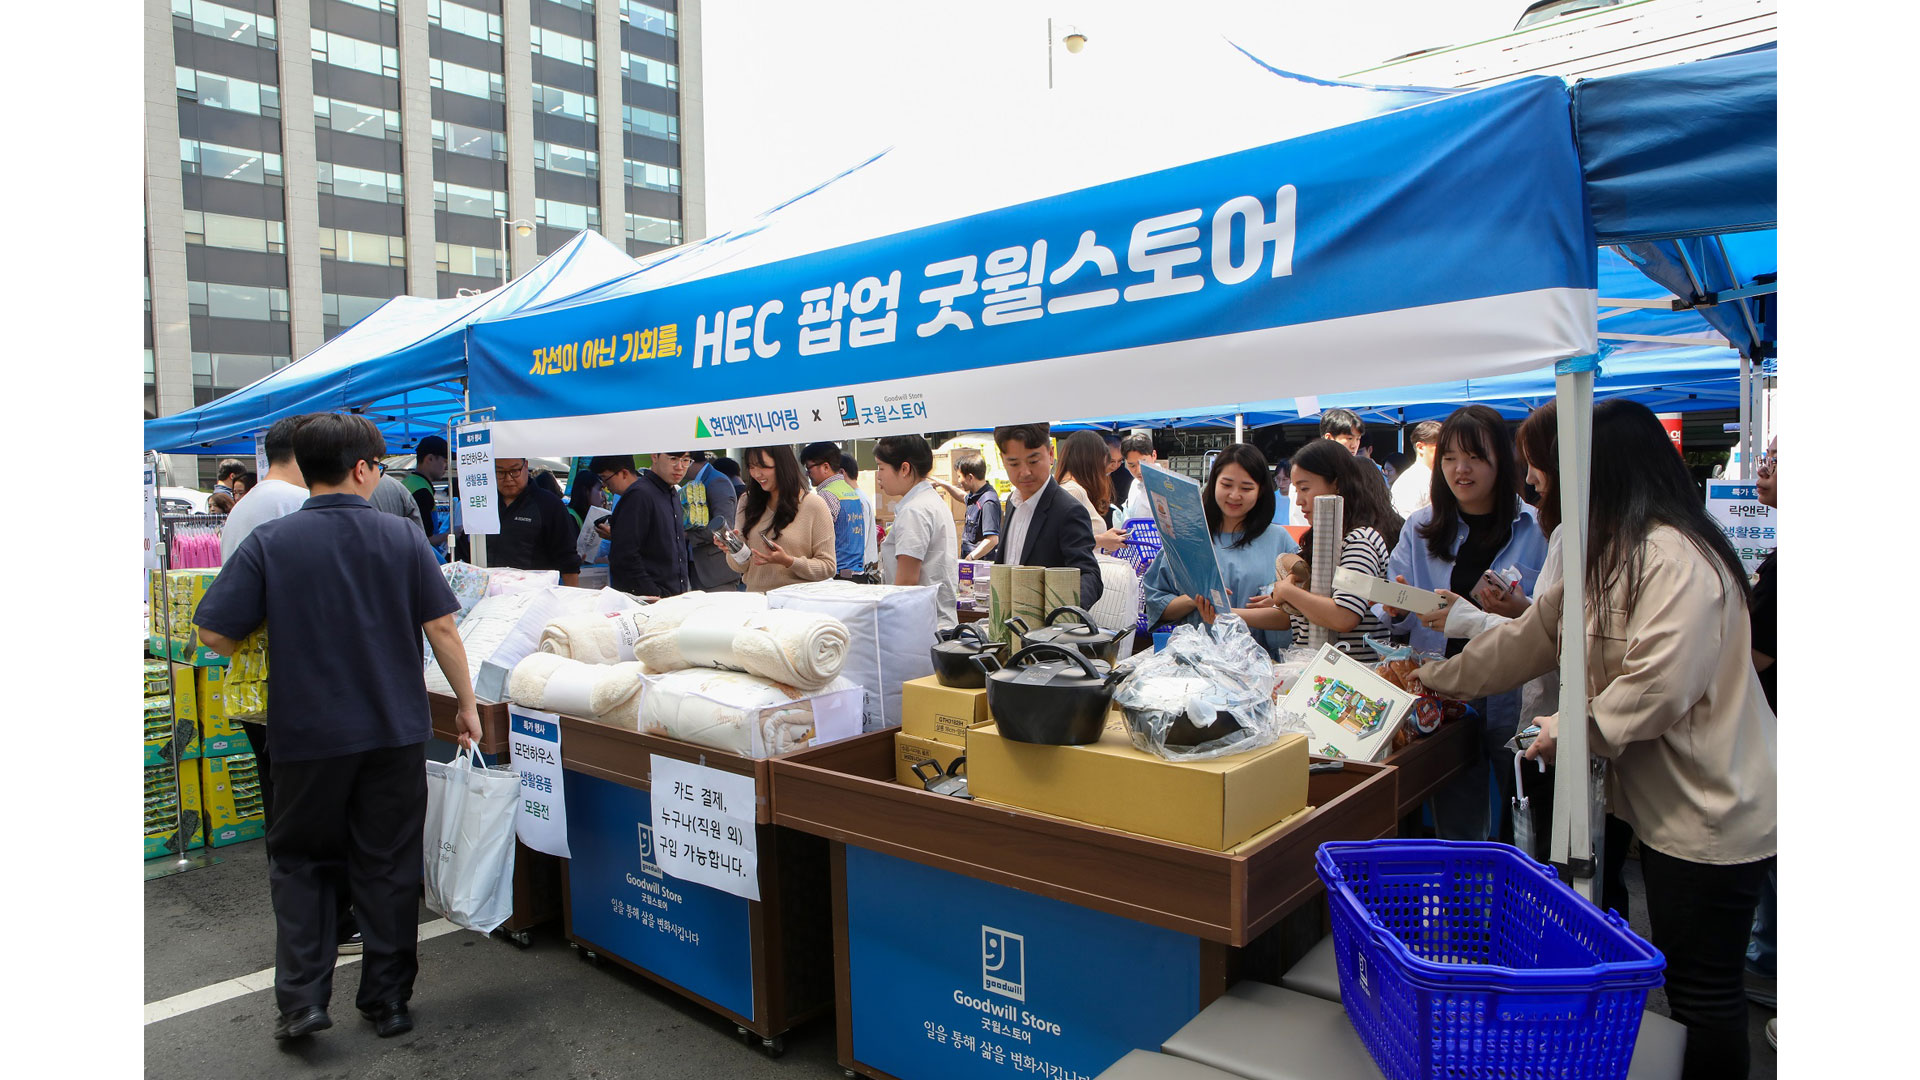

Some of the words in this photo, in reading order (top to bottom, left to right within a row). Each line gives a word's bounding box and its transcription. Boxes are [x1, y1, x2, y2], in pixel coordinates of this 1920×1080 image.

[529, 342, 578, 375] 자선이
[582, 335, 616, 369] 아닌
[619, 323, 682, 362] 기회를,
[692, 300, 784, 369] HEC
[798, 270, 901, 356] 팝업
[916, 184, 1297, 338] 굿윌스토어
[884, 394, 907, 402] Goodwill
[709, 408, 800, 437] 현대엔지니어링
[861, 401, 927, 424] 굿윌스토어
[461, 452, 488, 465] 모던하우스
[465, 473, 488, 487] 생활용품
[470, 494, 487, 508] 모음전
[1731, 488, 1749, 496] 특가
[1729, 505, 1770, 517] 락앤락
[1723, 526, 1776, 539] 생활용품
[523, 720, 533, 732] 특가
[534, 722, 545, 735] 행사
[515, 742, 555, 765] 모던하우스
[520, 770, 552, 793] 생활용품
[674, 781, 694, 802] 카드
[701, 788, 727, 813] 결제,
[525, 799, 549, 820] 모음전
[661, 807, 721, 840] 누구나(직원
[727, 825, 743, 846] 외)
[659, 835, 677, 858] 구입
[683, 844, 746, 877] 가능합니다.
[626, 872, 660, 895] Goodwill
[661, 886, 682, 904] Store
[641, 892, 668, 911] 굿윌스토어
[611, 898, 624, 915] 일을
[626, 904, 639, 920] 통해
[641, 910, 655, 928] 삶을
[657, 917, 699, 946] 변화시킵니다
[986, 978, 1022, 995] goodwill
[953, 989, 1017, 1022] Goodwill
[1021, 1010, 1061, 1036] Store
[981, 1017, 1031, 1045] 굿윌스토어
[923, 1020, 948, 1044] 일을
[951, 1030, 975, 1052] 통해
[979, 1041, 1006, 1065] 삶을
[1010, 1051, 1090, 1080] 변화시킵니
